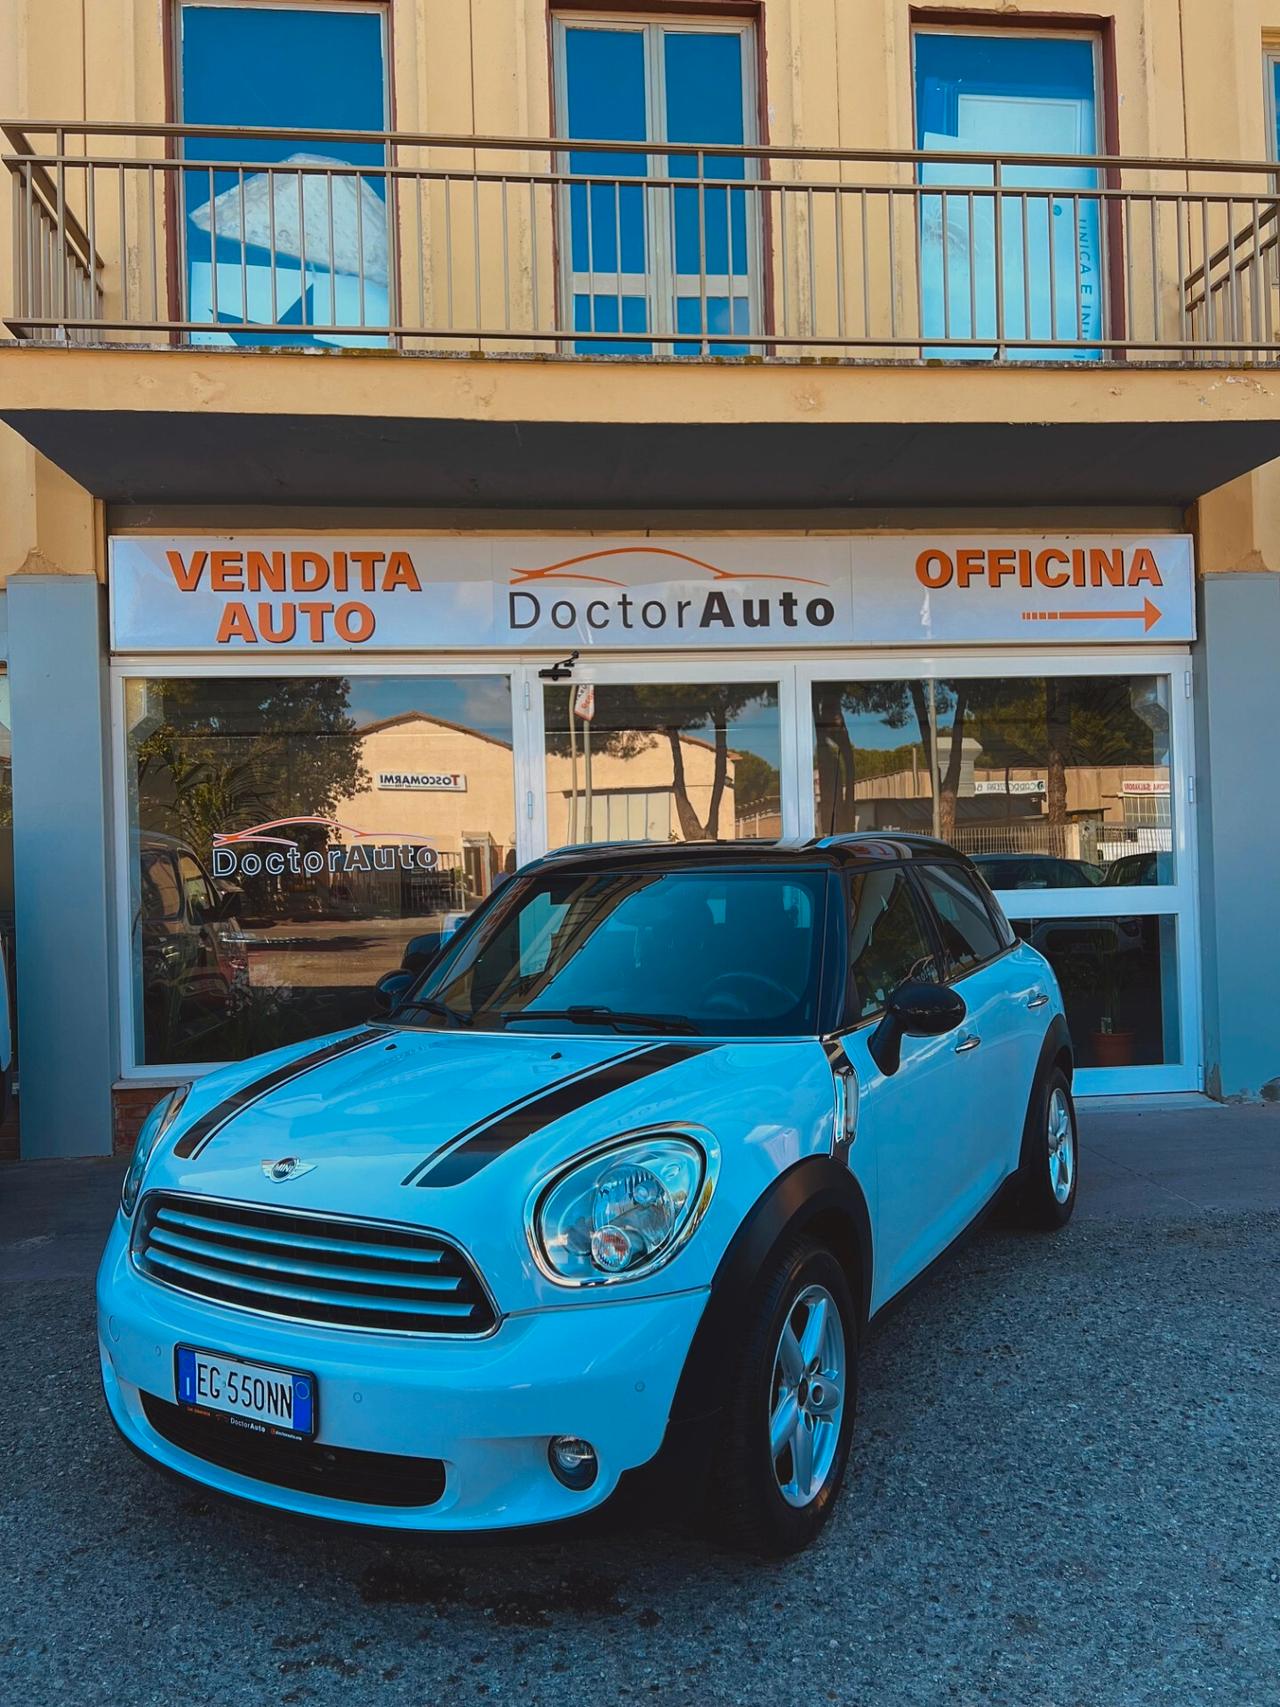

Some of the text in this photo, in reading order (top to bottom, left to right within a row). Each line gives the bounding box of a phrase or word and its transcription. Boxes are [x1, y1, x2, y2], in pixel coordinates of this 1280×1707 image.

[167, 551, 423, 592] VENDITA
[915, 548, 1164, 588] OFFICINA
[216, 602, 376, 643] AUTO
[509, 591, 836, 629] DoctorAuto
[213, 844, 439, 877] DoctorAuto
[230, 1417, 266, 1433] DoctorAuto
